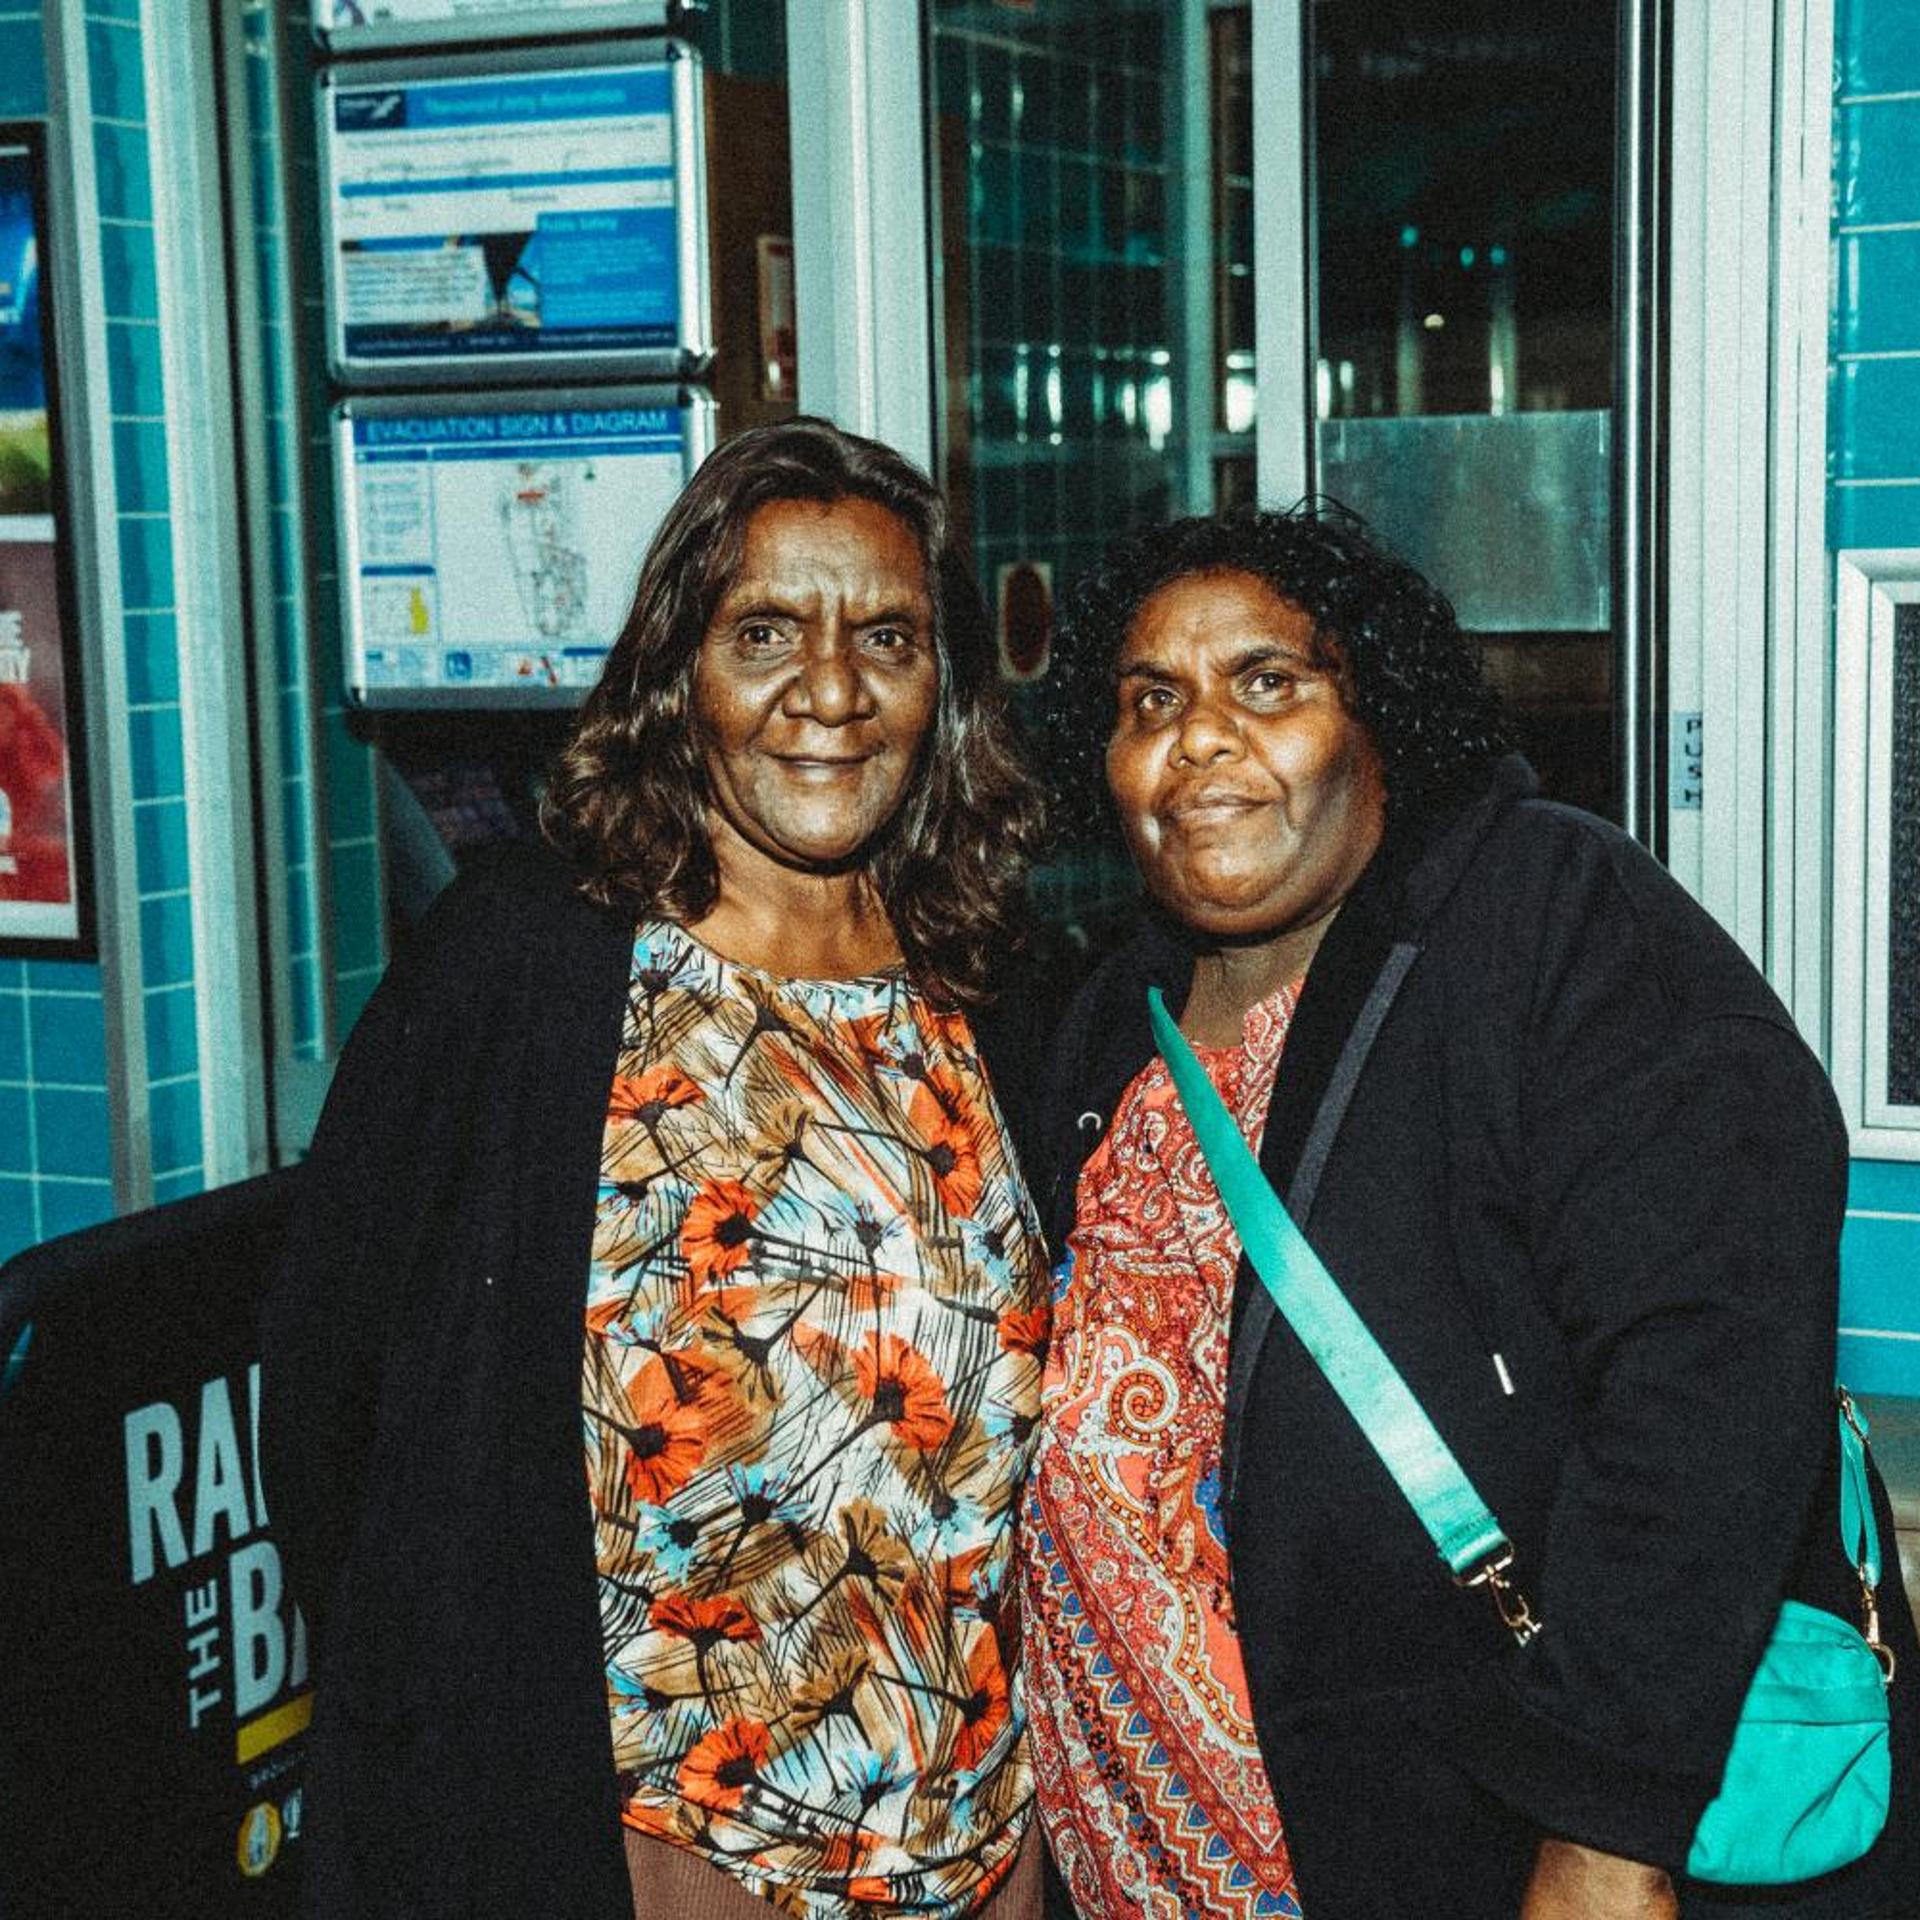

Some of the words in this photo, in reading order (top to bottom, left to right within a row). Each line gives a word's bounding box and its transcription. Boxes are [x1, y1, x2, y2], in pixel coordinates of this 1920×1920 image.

[366, 416, 495, 442] EVACUATION
[500, 414, 549, 436] SIGN
[553, 412, 567, 434] &
[570, 410, 668, 433] DIAGRAM
[184, 1578, 222, 1729] THE
